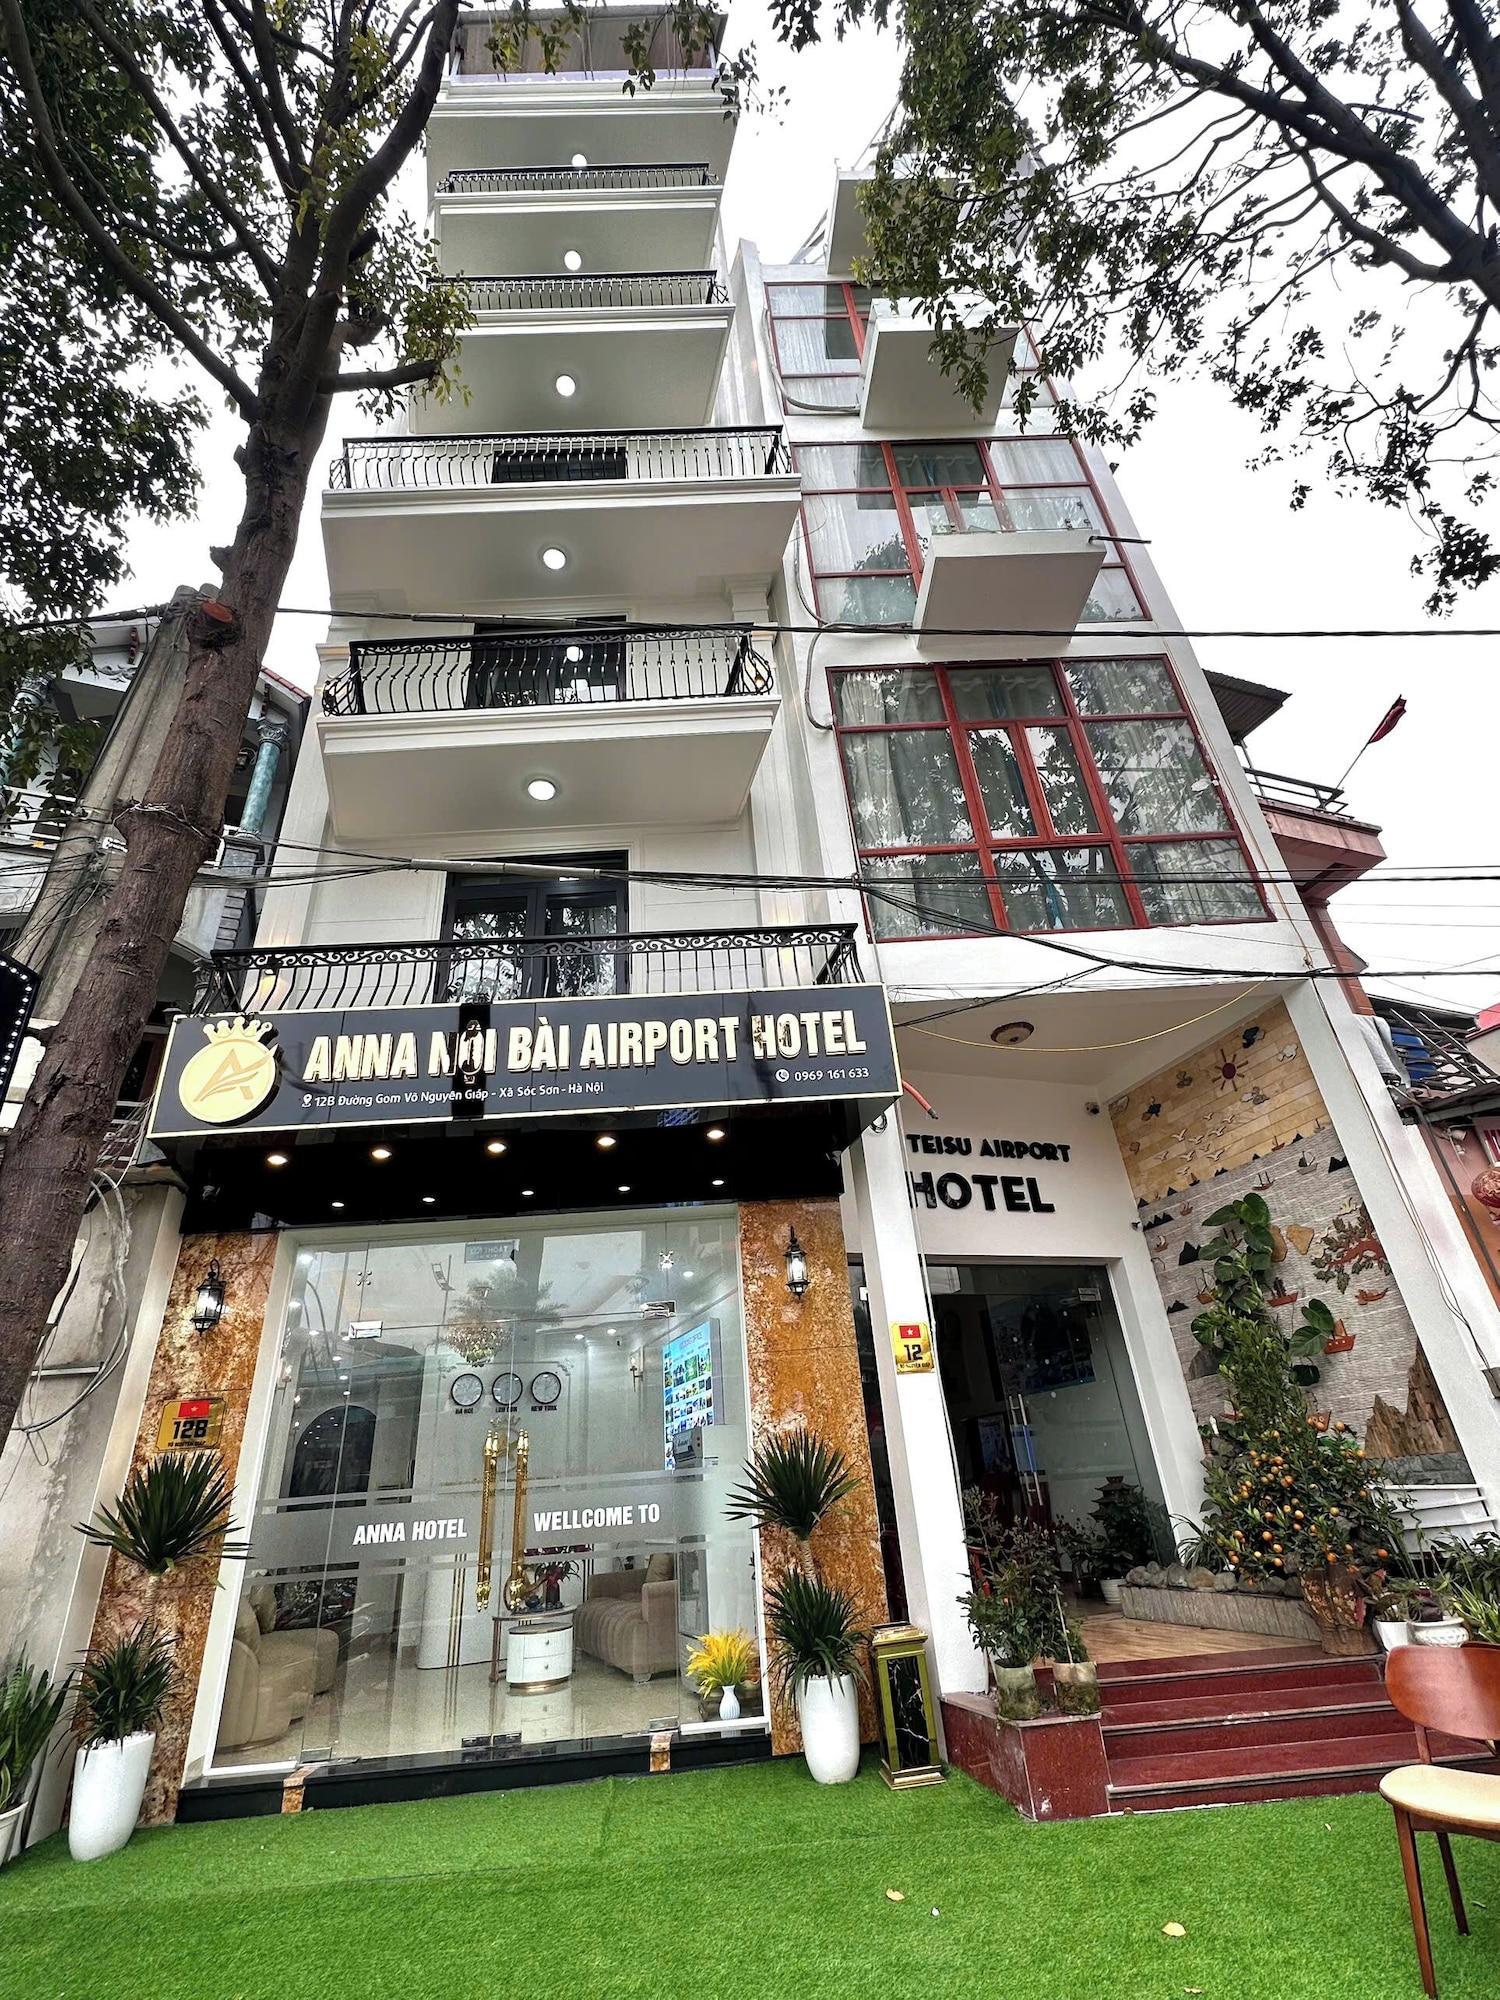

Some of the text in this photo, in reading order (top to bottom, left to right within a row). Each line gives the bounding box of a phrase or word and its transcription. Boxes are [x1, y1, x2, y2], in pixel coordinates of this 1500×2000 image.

[302, 1032, 418, 1083] ANNA
[507, 1016, 571, 1074] BÀI
[579, 1016, 741, 1070] AIRPORT
[751, 1010, 867, 1061] HOTEL
[794, 1067, 870, 1082] 0969 161 633
[315, 1096, 335, 1107] 12B
[338, 1095, 373, 1108] Đường
[375, 1093, 401, 1105] Gom
[404, 1092, 418, 1103] Võ
[465, 1089, 489, 1101] Giáp
[499, 1087, 514, 1098] Xã
[517, 1086, 537, 1097] Sóc
[540, 1084, 560, 1095] Sơn
[568, 1083, 583, 1094] Hà
[585, 1082, 604, 1095] Nội
[906, 1134, 1071, 1163] TEISU AIRPORT
[905, 1170, 1056, 1213] HOTEL
[903, 1344, 923, 1361] 12
[173, 1419, 209, 1439] 12B
[533, 1503, 661, 1532] WELLCOME TO
[352, 1518, 468, 1546] ANNA HOTEL
